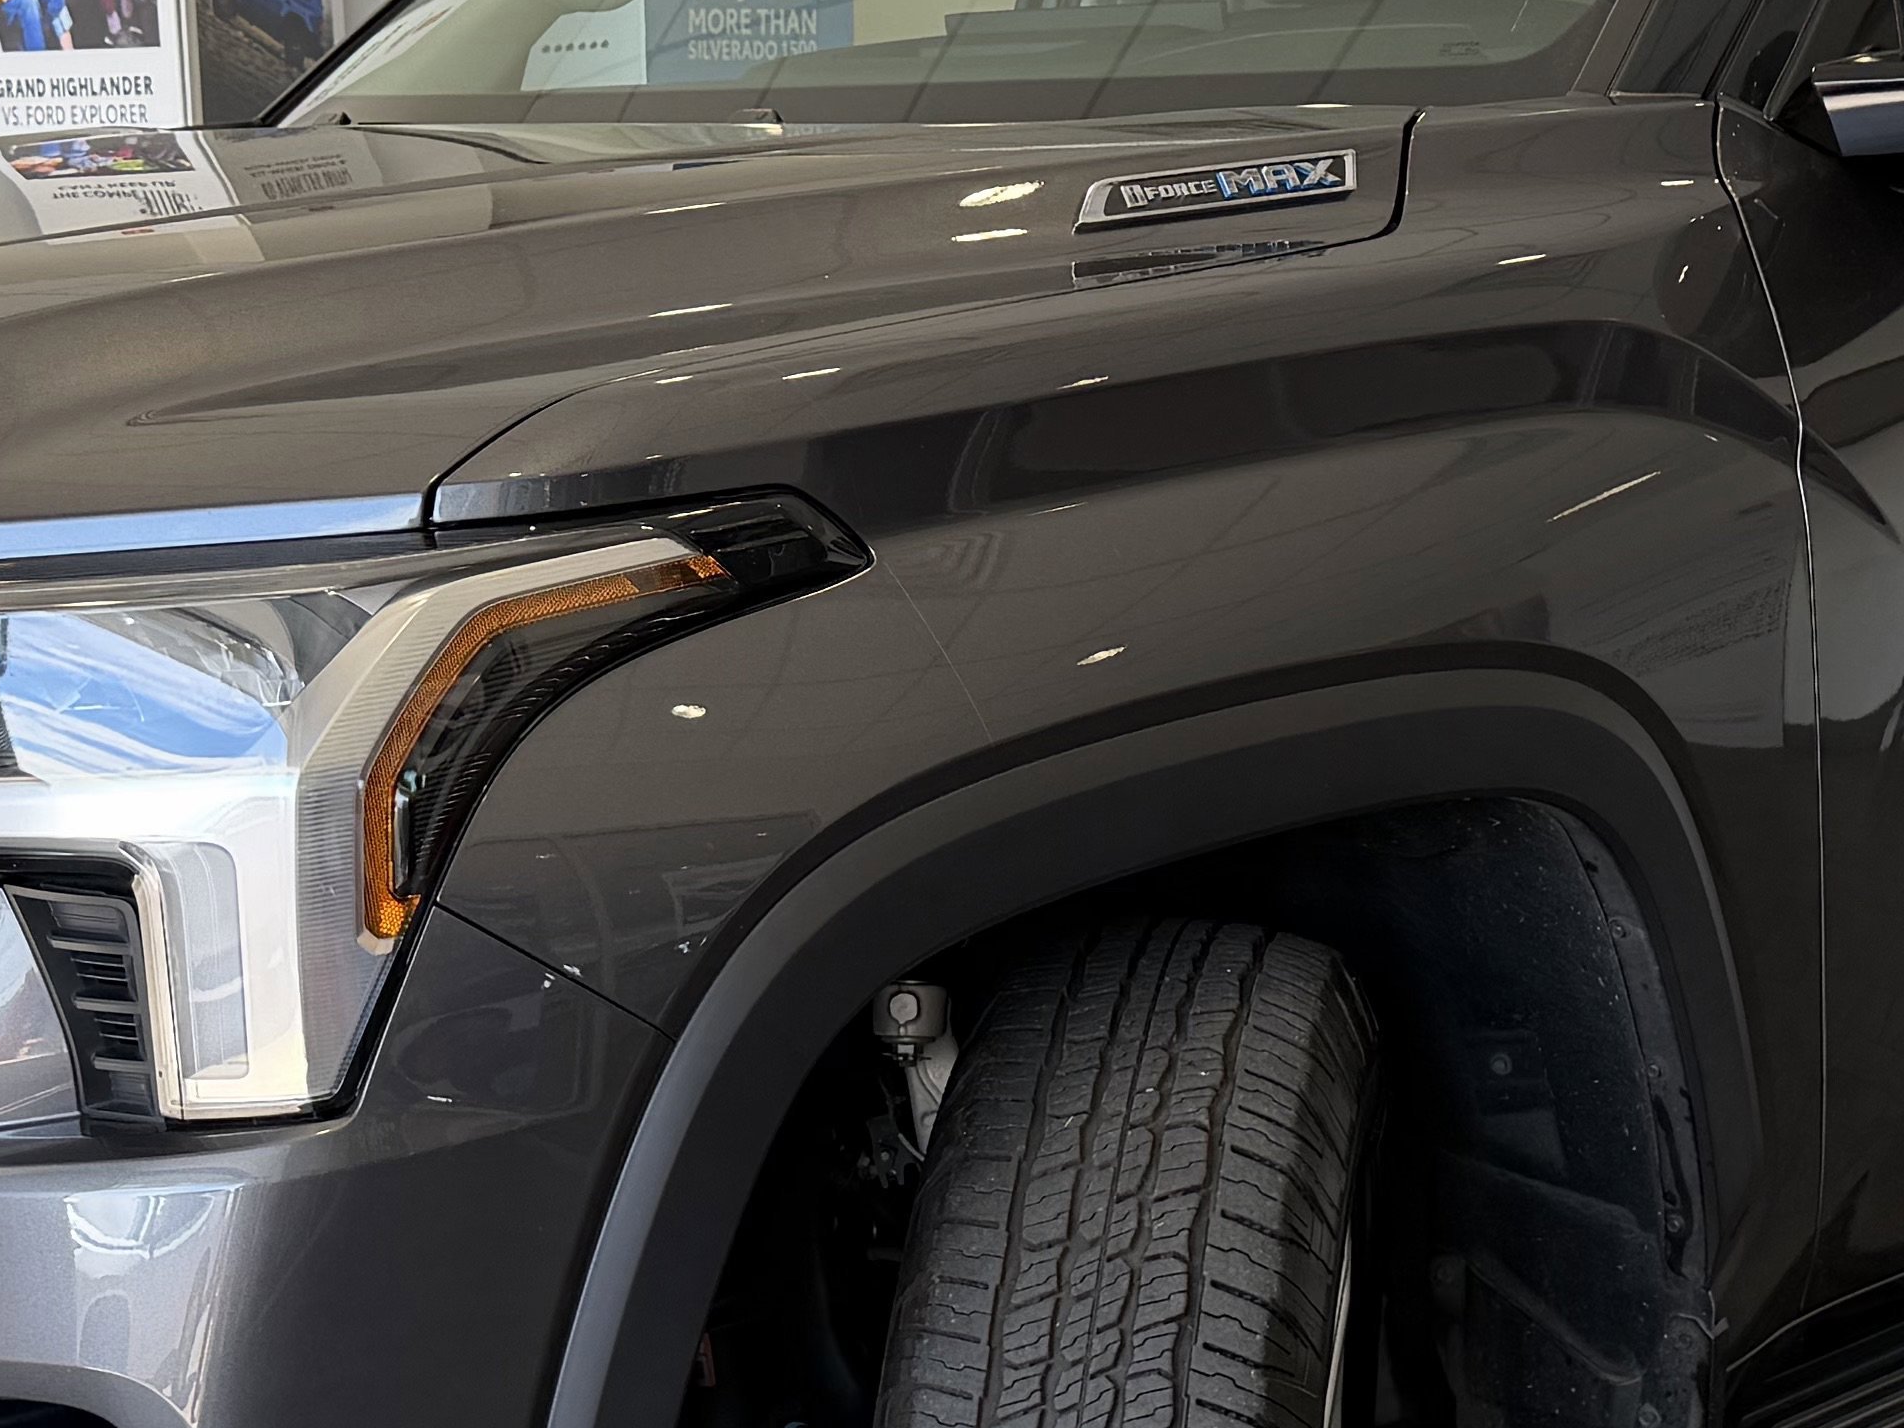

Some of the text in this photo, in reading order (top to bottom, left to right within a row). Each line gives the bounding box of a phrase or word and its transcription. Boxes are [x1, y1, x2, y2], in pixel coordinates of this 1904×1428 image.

[688, 8, 817, 35] MORE THAN
[688, 39, 778, 61] SILVERADO
[51, 75, 154, 96] HIGHLANDER
[2, 103, 148, 127] VS. FORD EXPLORER
[1216, 158, 1344, 200] MAX
